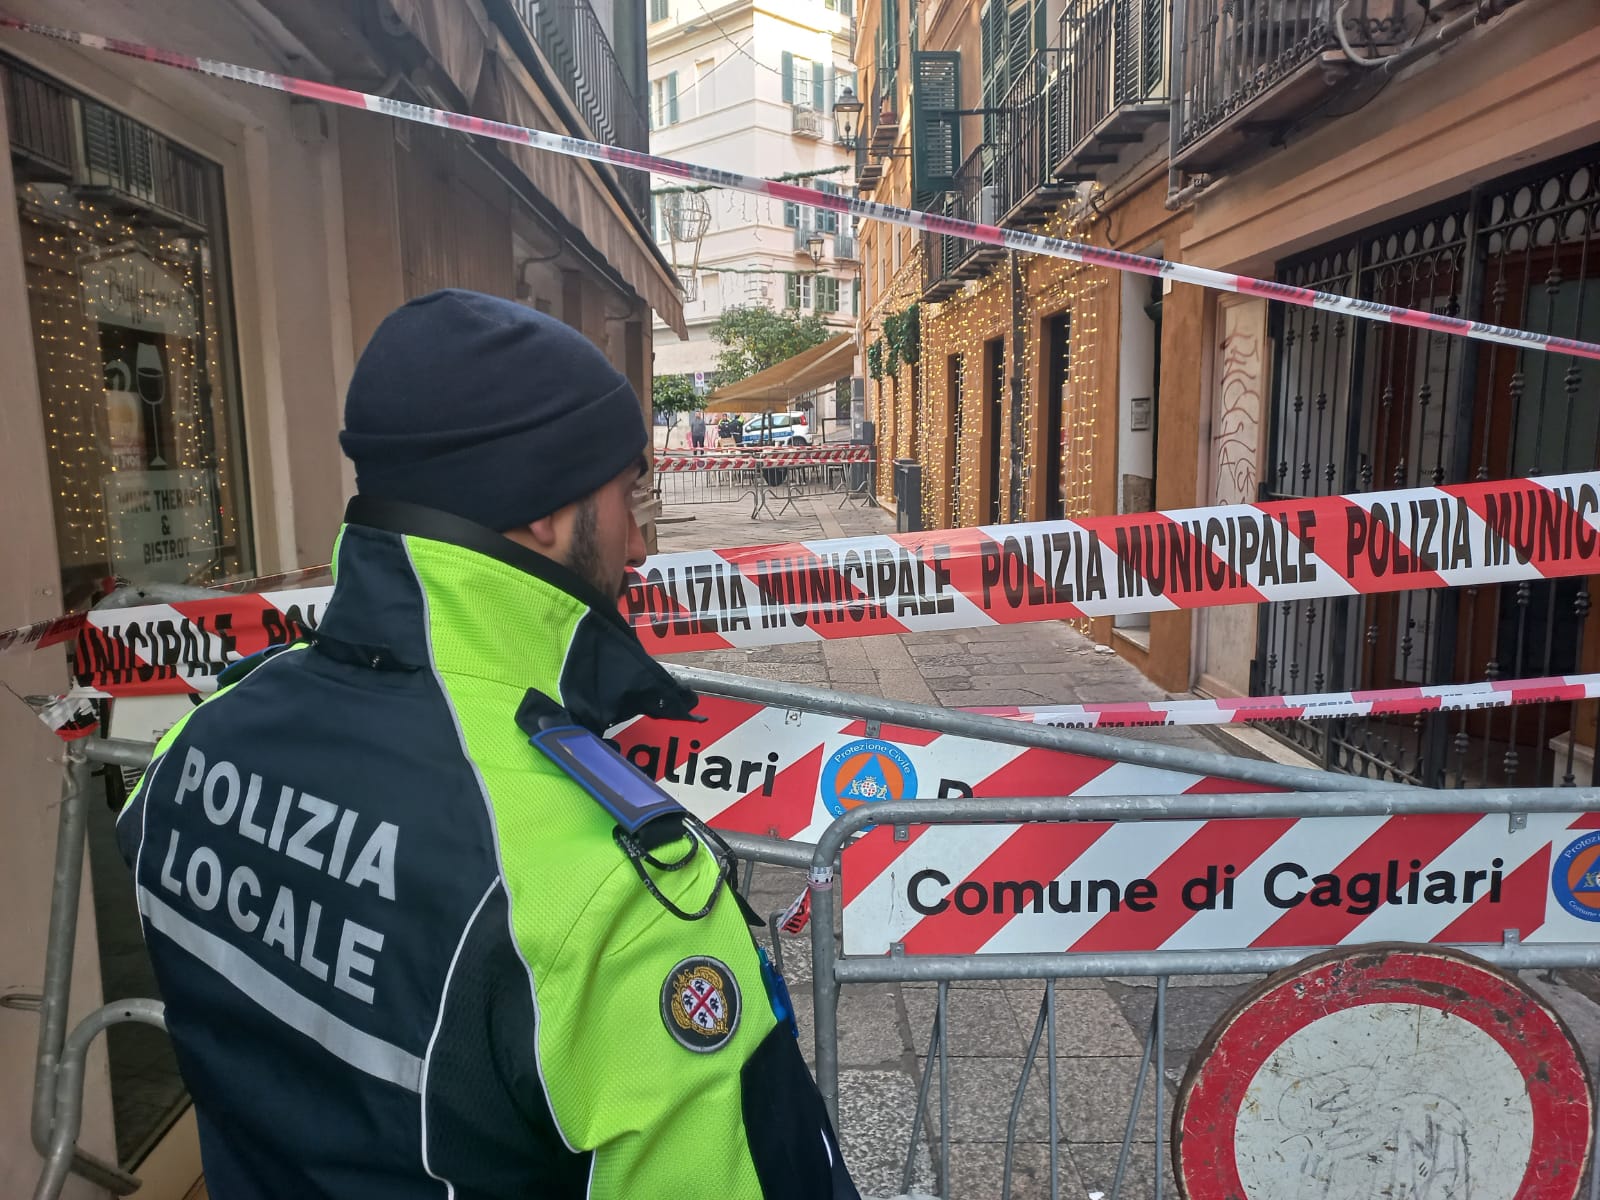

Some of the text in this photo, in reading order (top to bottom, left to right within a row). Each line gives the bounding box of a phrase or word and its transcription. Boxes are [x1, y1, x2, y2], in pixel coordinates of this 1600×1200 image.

[143, 537, 190, 565] BISTROT
[161, 515, 171, 536] &
[73, 614, 237, 688] UNICIPALE
[626, 563, 751, 638] POLIZIA
[755, 543, 955, 629] MUNICIPALE
[981, 530, 1107, 610] POLIZIA
[1116, 510, 1317, 599] MUNICIPALE
[1345, 496, 1472, 579] POLIZIA
[1484, 484, 1600, 568] MUNIC
[602, 736, 779, 797] gliari
[834, 742, 911, 774] Protezione Civile
[174, 746, 399, 901] POLIZIA
[1563, 835, 1600, 859] Protezi
[906, 857, 1504, 916] Comune di Cagliari
[160, 829, 385, 1005] LOCALE
